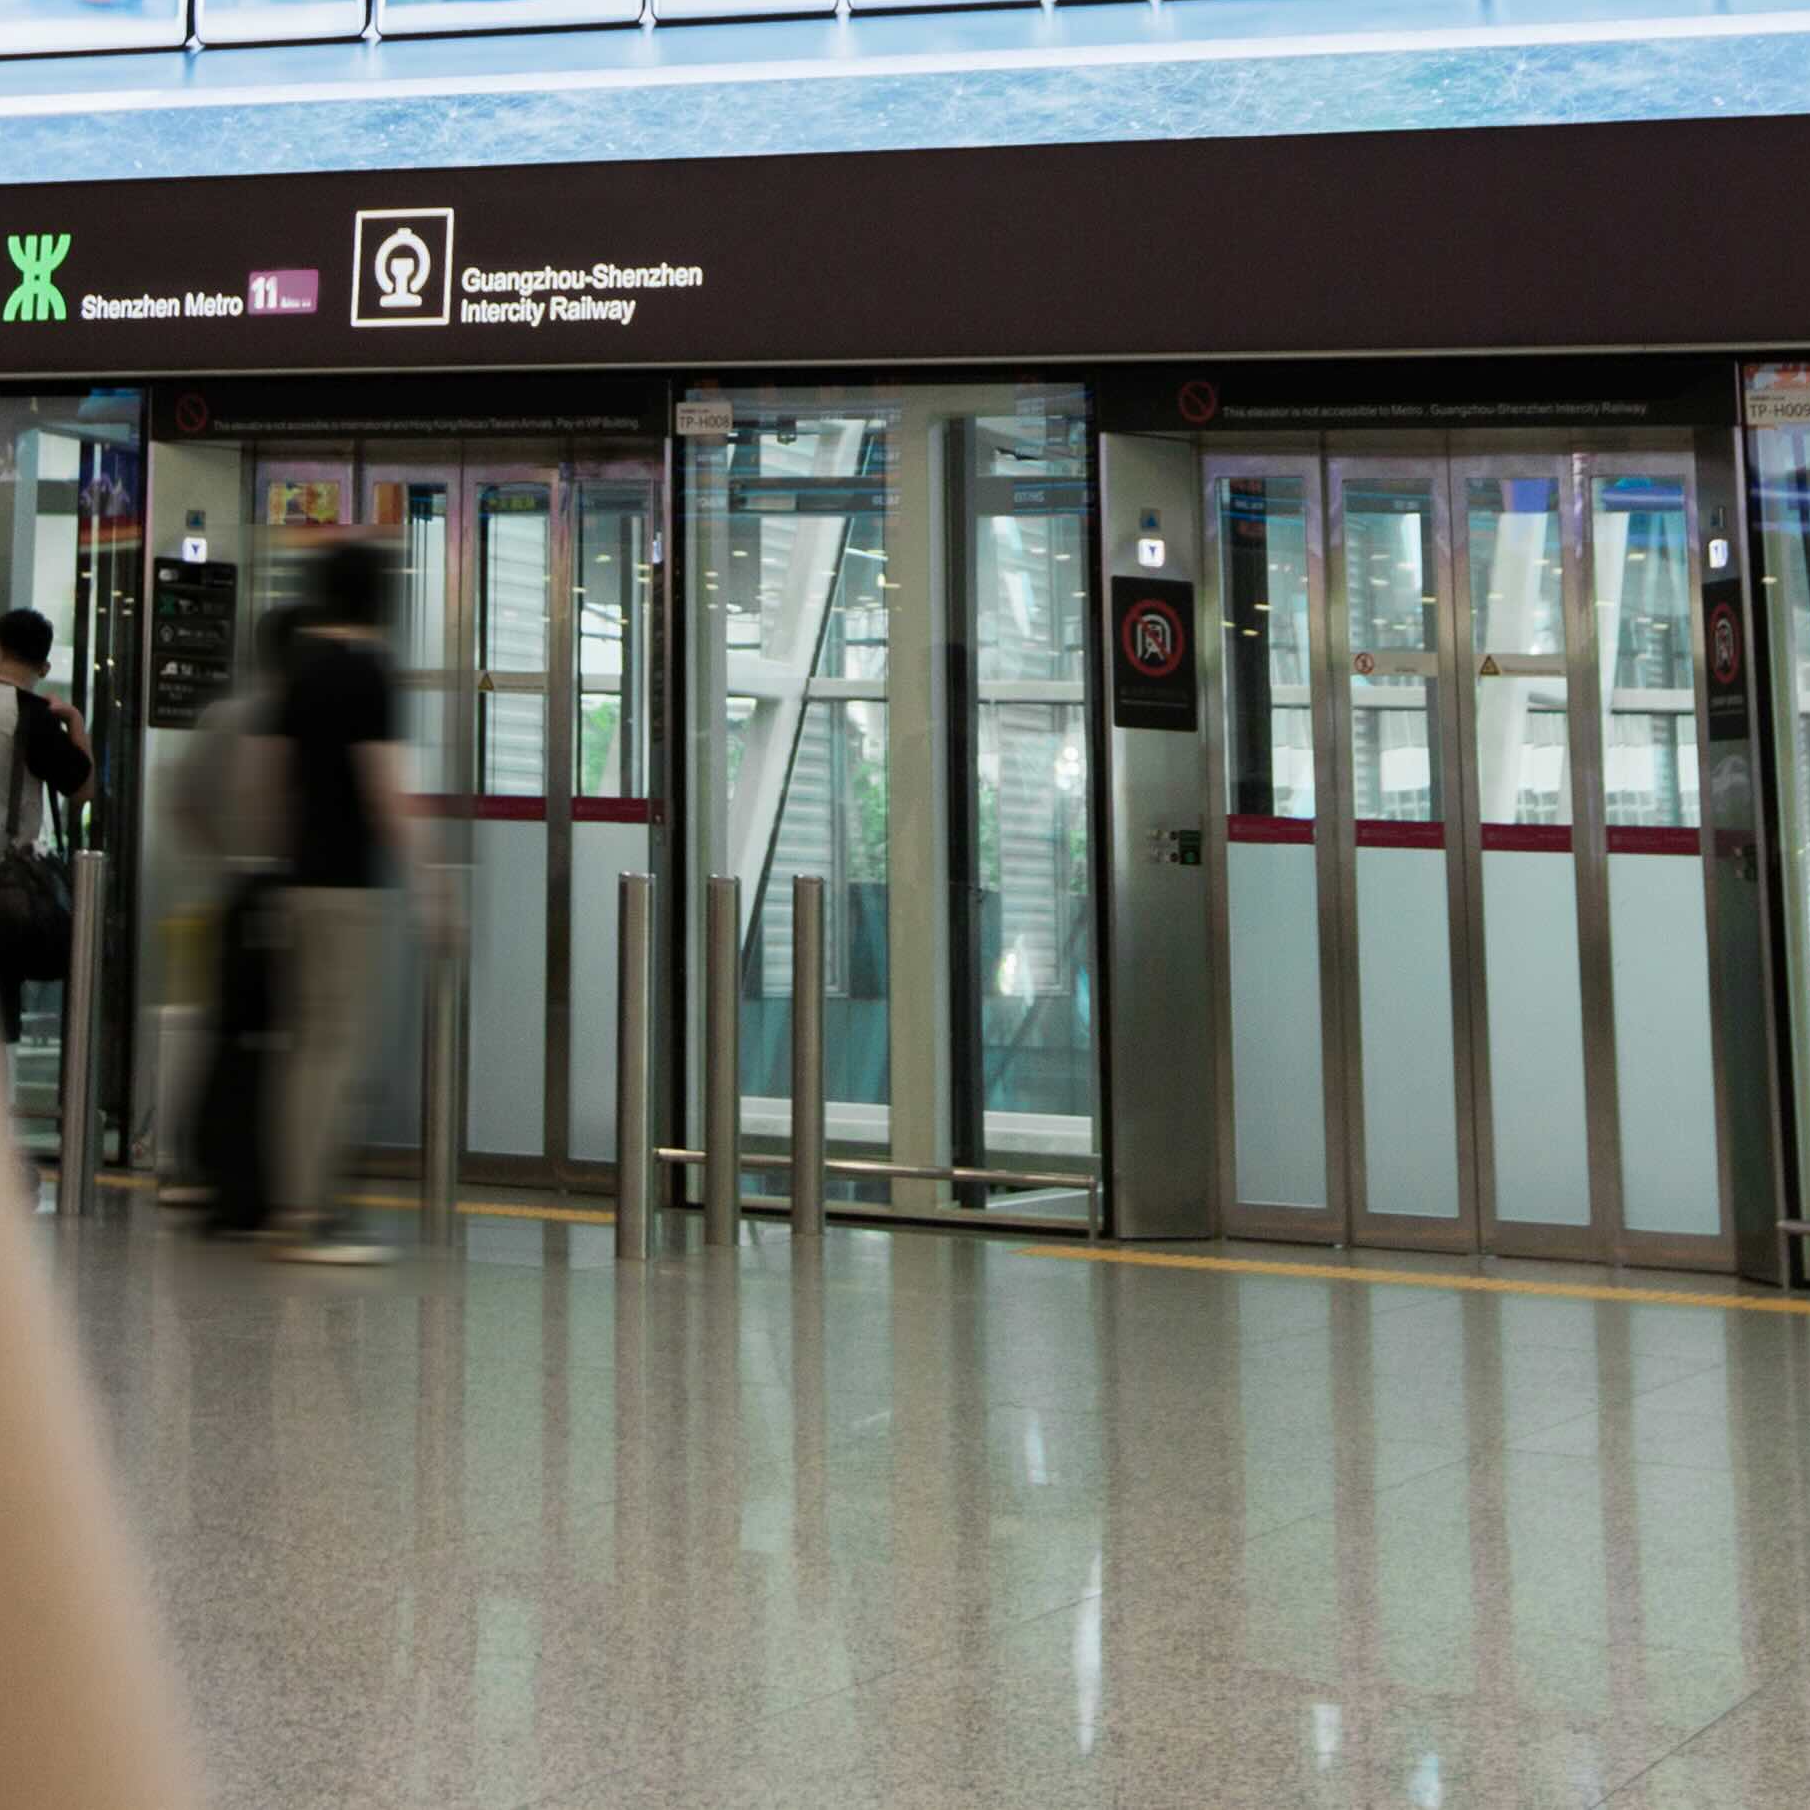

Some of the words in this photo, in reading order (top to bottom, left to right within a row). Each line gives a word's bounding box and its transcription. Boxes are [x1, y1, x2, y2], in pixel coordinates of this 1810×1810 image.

[461, 262, 703, 296] Guangzhou-Shenzhen
[81, 293, 181, 320] Shenzhen
[184, 291, 244, 317] Metro
[460, 296, 545, 327] Intercity
[549, 294, 637, 326] Railway
